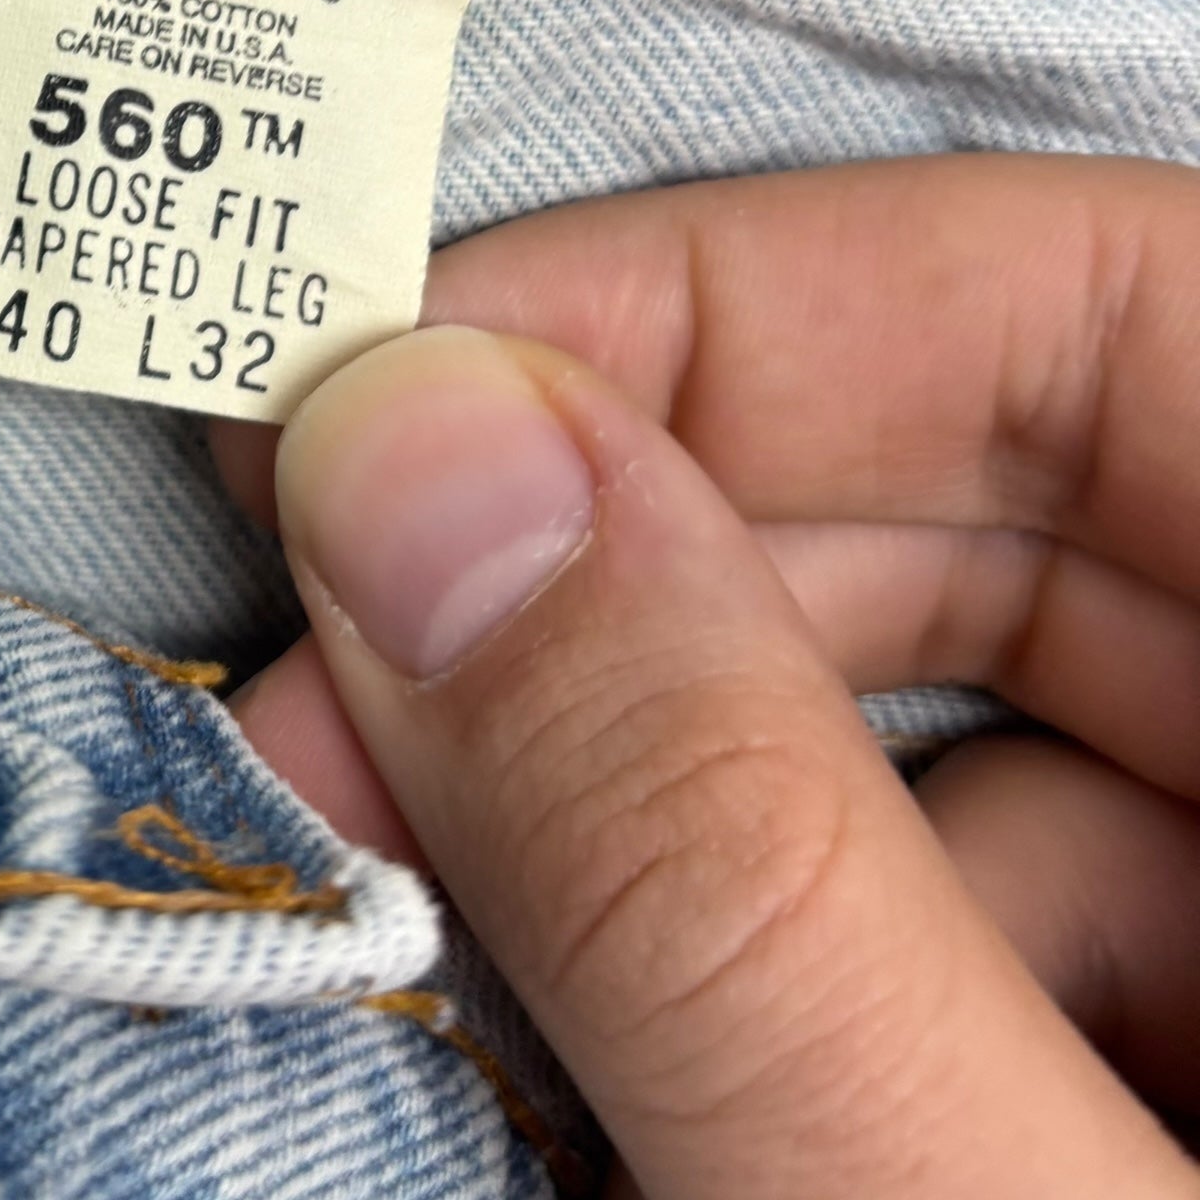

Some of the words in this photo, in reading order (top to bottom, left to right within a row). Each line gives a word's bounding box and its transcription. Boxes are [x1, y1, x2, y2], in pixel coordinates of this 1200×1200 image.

[55, 29, 135, 65] CARE
[140, 44, 183, 75] ON
[188, 55, 325, 102] REVERSE
[93, 7, 175, 44] MADE
[180, 23, 209, 49] IN
[216, 30, 295, 67] U.S.A.
[16, 151, 184, 231] LOOSE
[211, 189, 301, 253] FIT
[232, 260, 328, 327] LEG
[138, 314, 276, 393] L32
